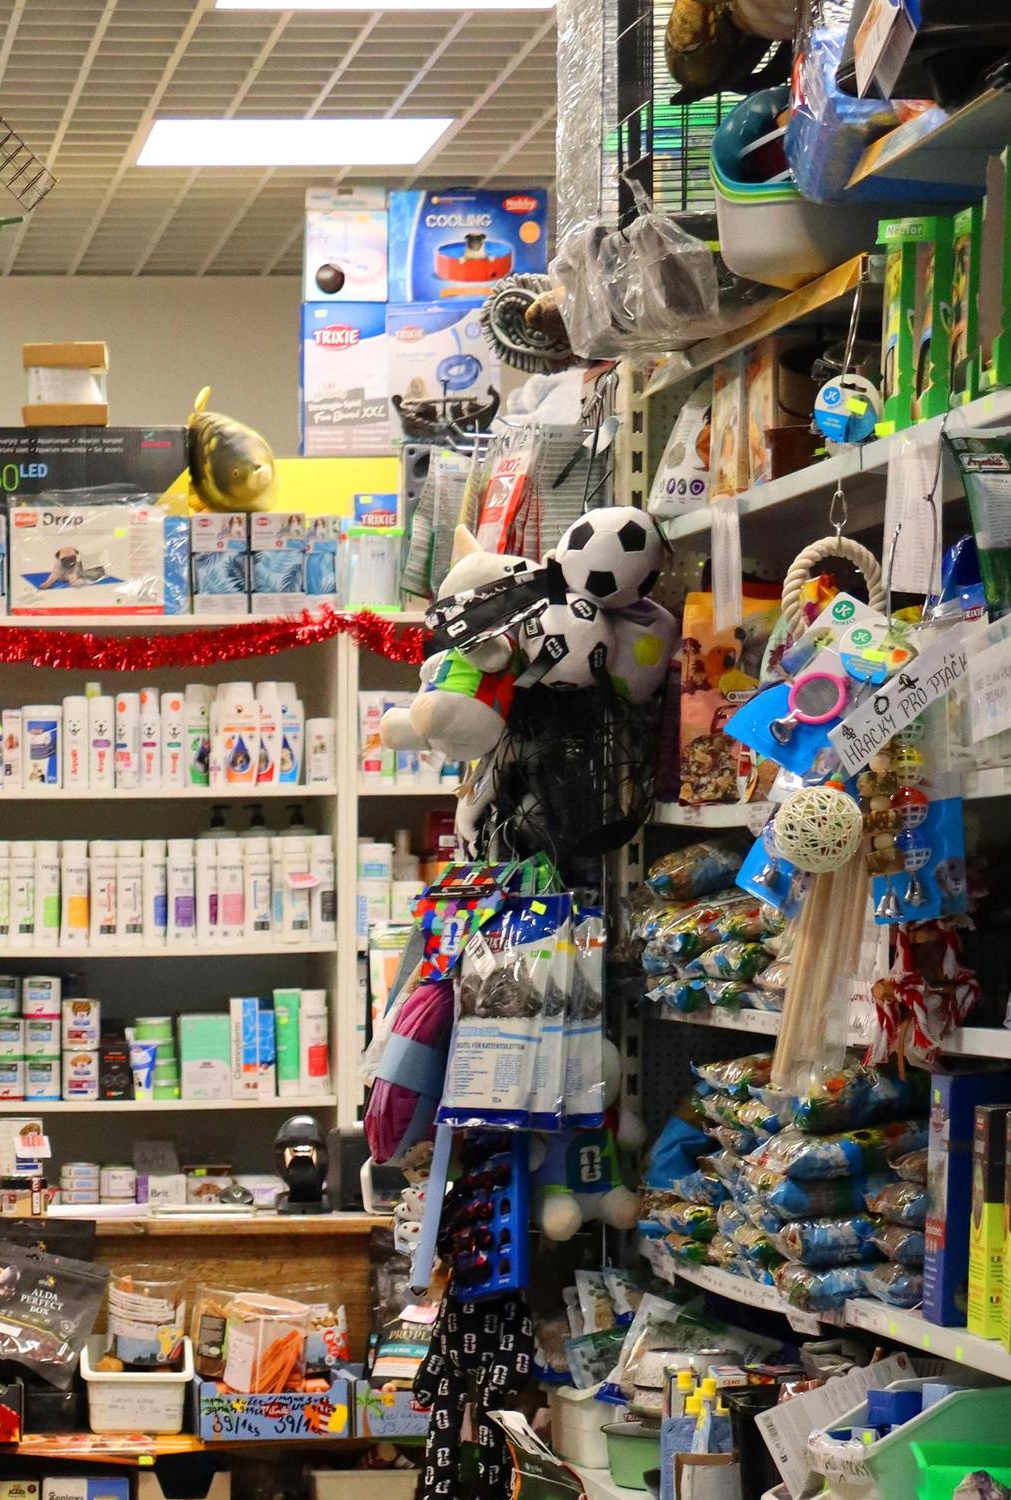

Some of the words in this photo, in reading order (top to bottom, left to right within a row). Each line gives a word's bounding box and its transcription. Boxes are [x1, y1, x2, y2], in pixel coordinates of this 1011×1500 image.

[426, 213, 492, 228] COOLING
[314, 326, 360, 345] TRIXIE
[20, 463, 48, 478] LED
[361, 514, 397, 526] TRIXIE
[843, 713, 897, 767] HRAČKY
[897, 690, 927, 720] PRO
[150, 1189, 170, 1200] Brit
[31, 1287, 59, 1301] ALDA
[20, 1294, 65, 1312] PERFECT
[29, 1304, 50, 1316] BOX
